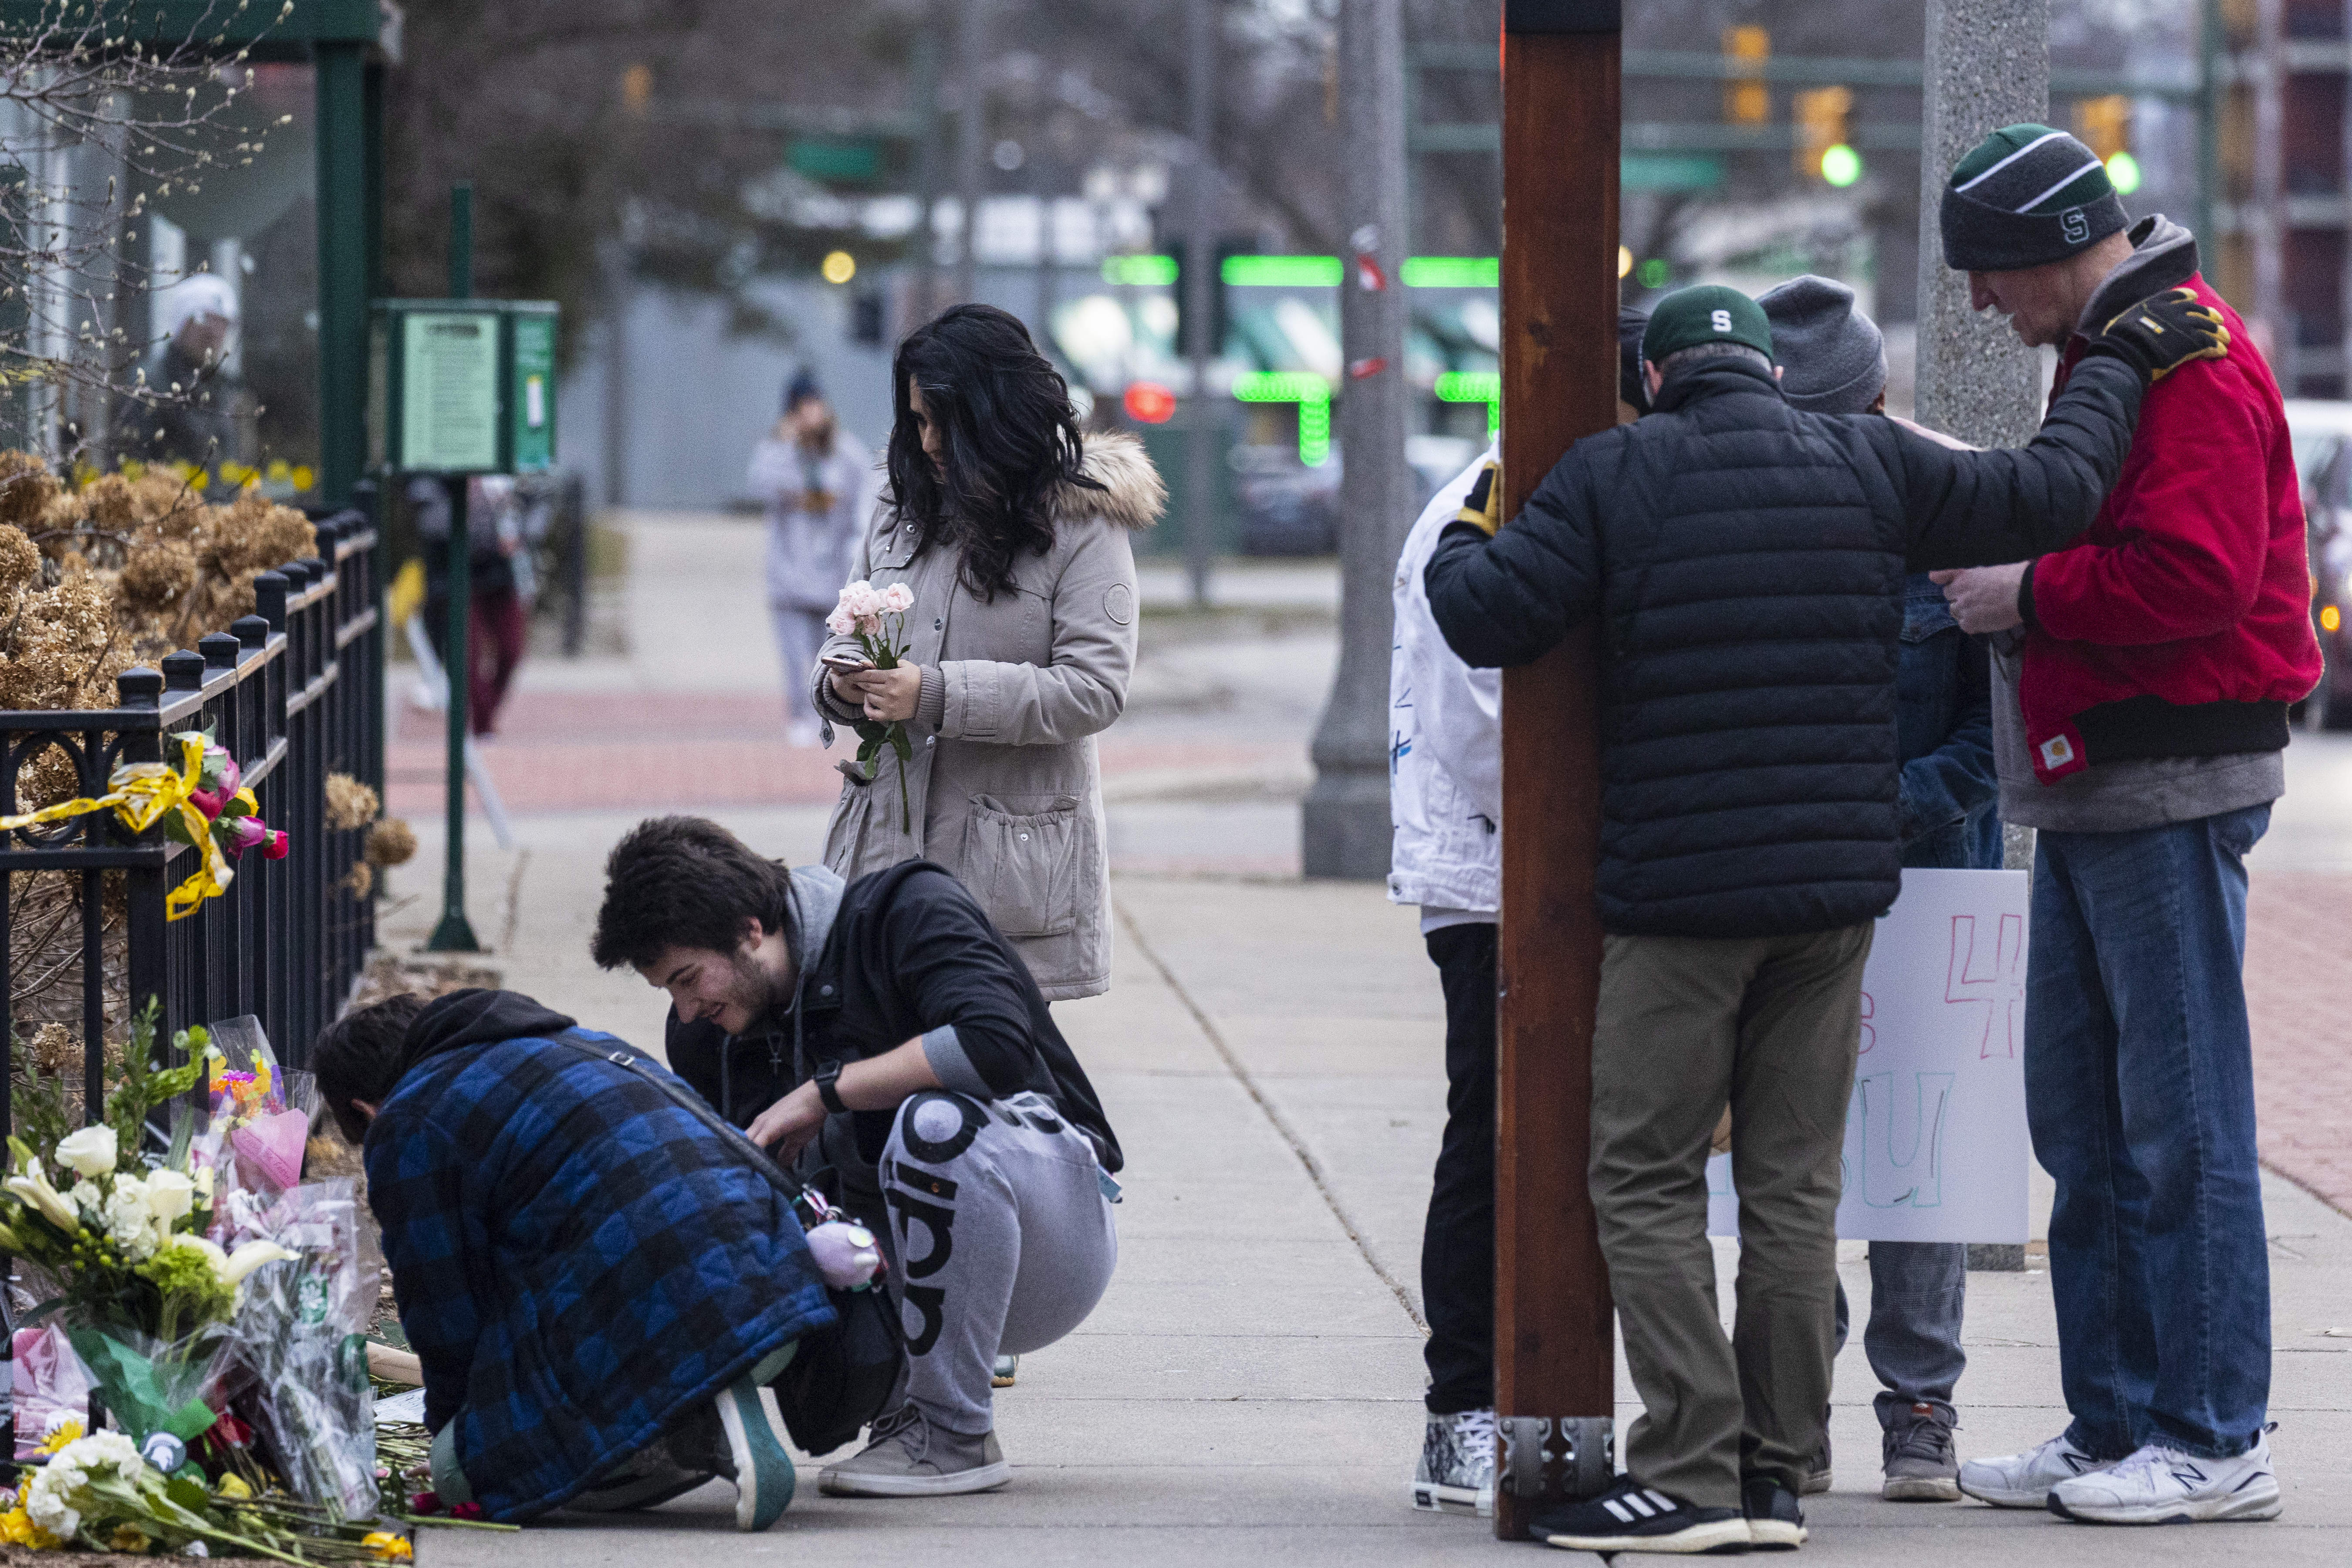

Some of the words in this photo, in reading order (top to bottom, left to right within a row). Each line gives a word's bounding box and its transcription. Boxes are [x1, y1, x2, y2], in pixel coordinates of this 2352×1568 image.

[2059, 206, 2089, 244] S
[1711, 309, 1732, 332] S
[1945, 913, 2023, 1059] 4
[1839, 1071, 1956, 1209] U
[2171, 1463, 2208, 1494] N
